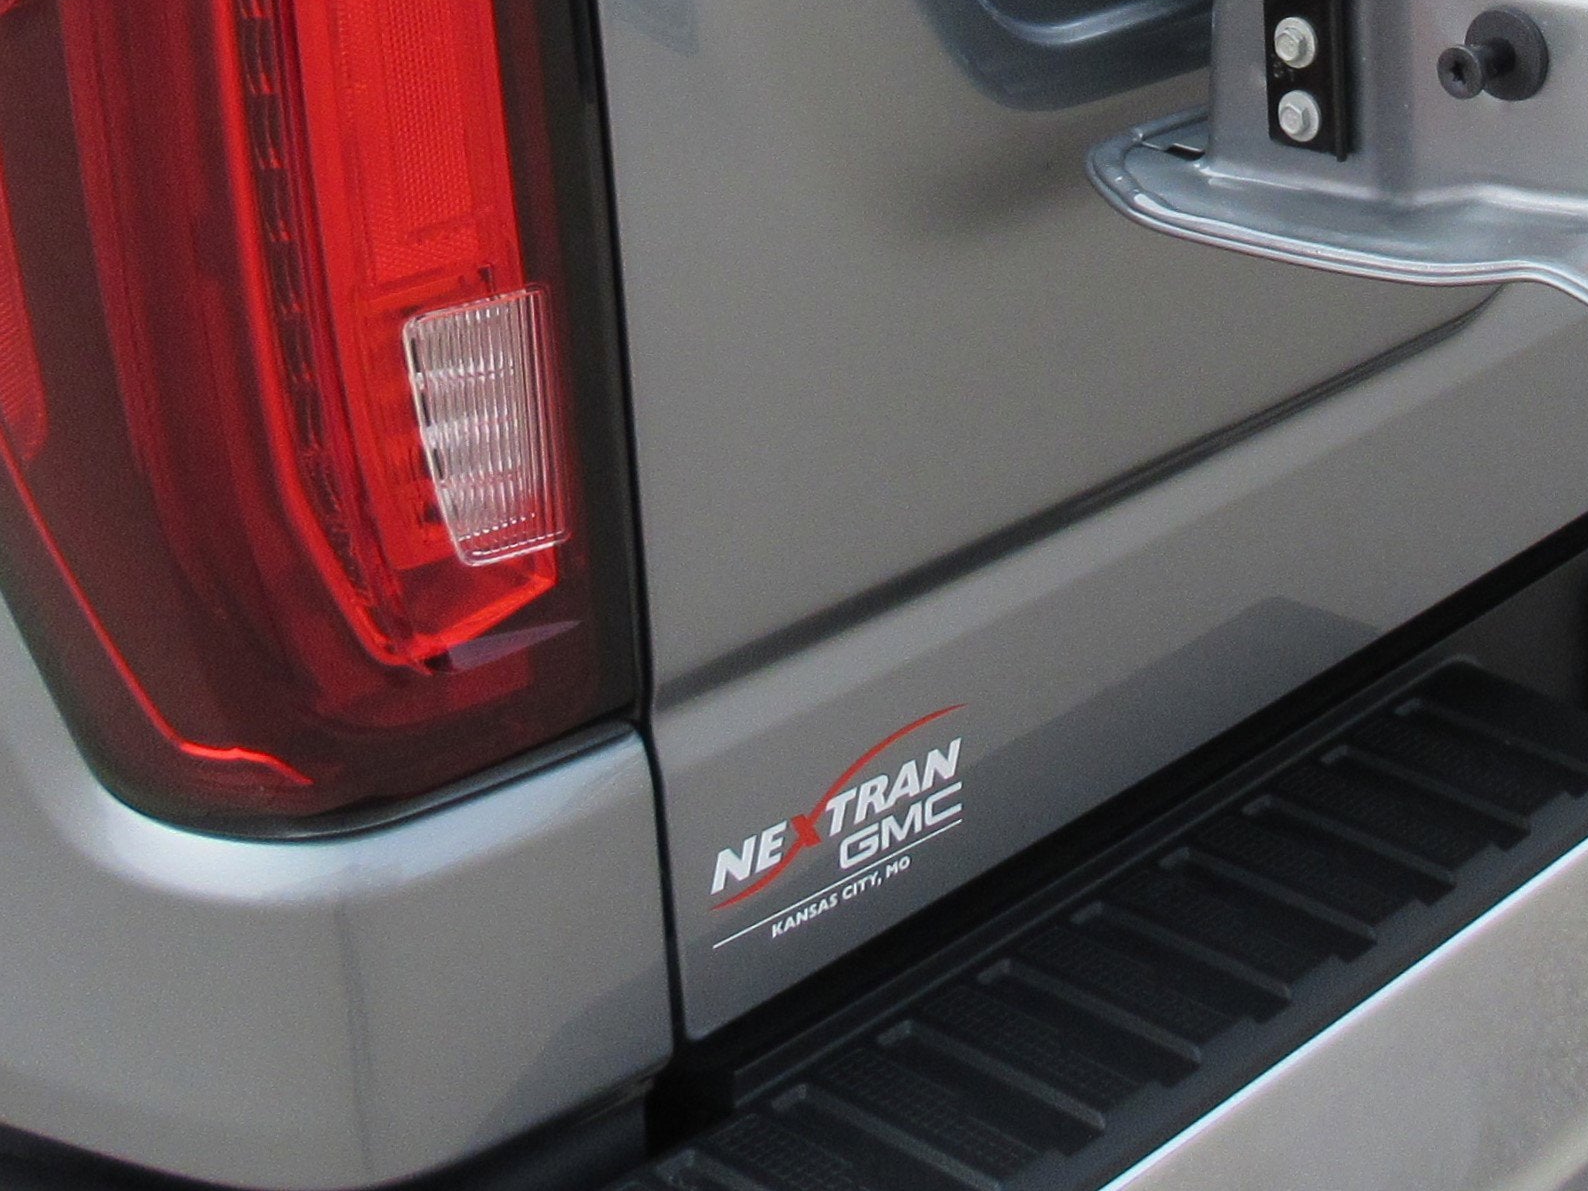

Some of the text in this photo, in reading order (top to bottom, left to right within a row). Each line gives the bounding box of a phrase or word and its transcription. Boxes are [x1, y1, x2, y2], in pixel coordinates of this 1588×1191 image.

[711, 738, 962, 895] NEXTRAN
[839, 781, 962, 870] GMC
[771, 855, 911, 938] KANSAS CITY, MO
